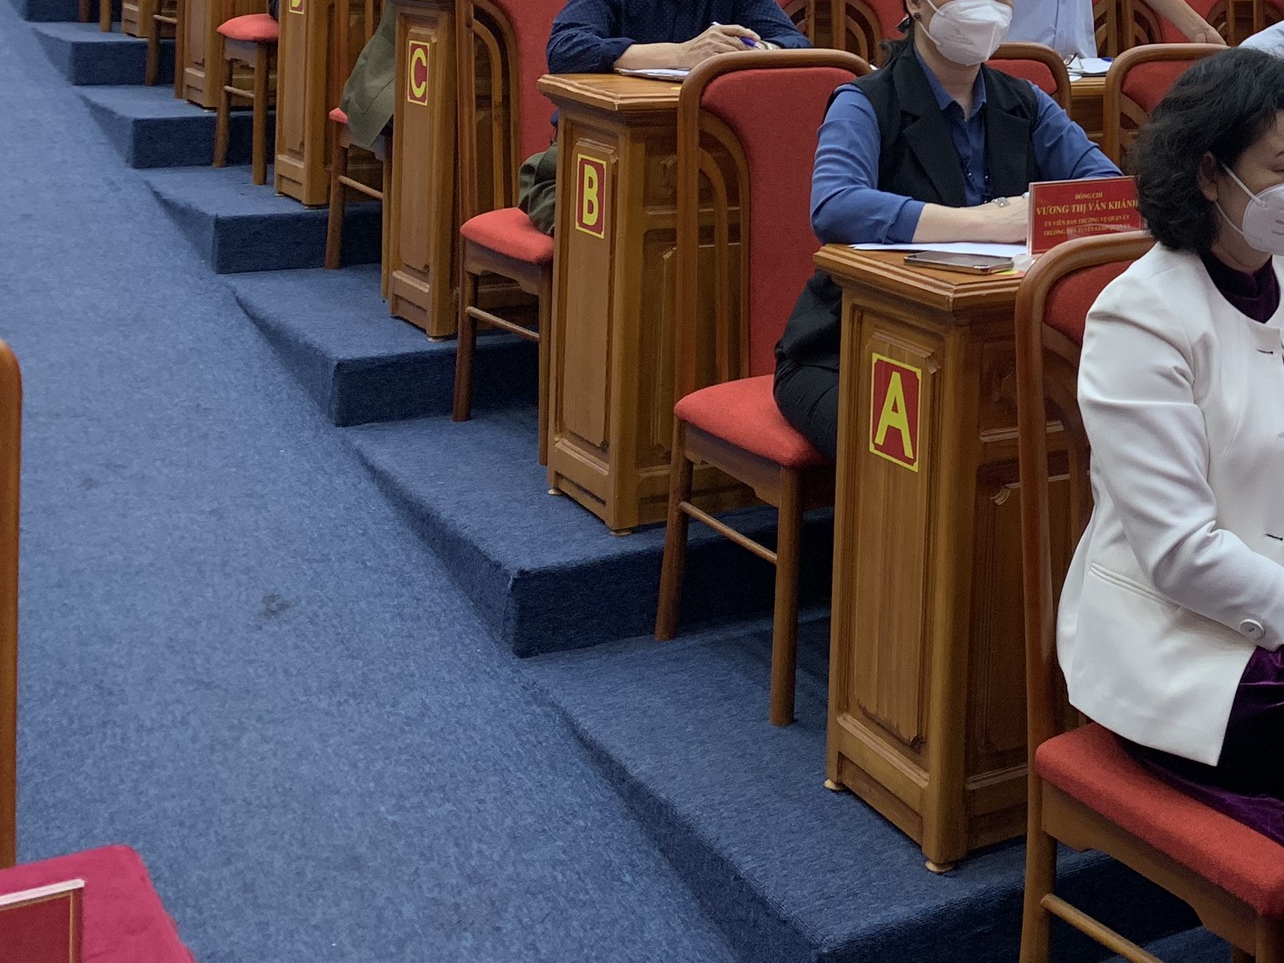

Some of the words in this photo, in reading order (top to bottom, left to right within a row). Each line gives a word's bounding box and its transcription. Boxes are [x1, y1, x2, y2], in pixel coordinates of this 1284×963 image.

[410, 47, 427, 98] C
[582, 163, 600, 226] B
[1036, 205, 1069, 216] VƯƠNG
[1071, 203, 1087, 214] THỊ
[1108, 198, 1138, 210] KHÁNH
[874, 371, 914, 459] A
